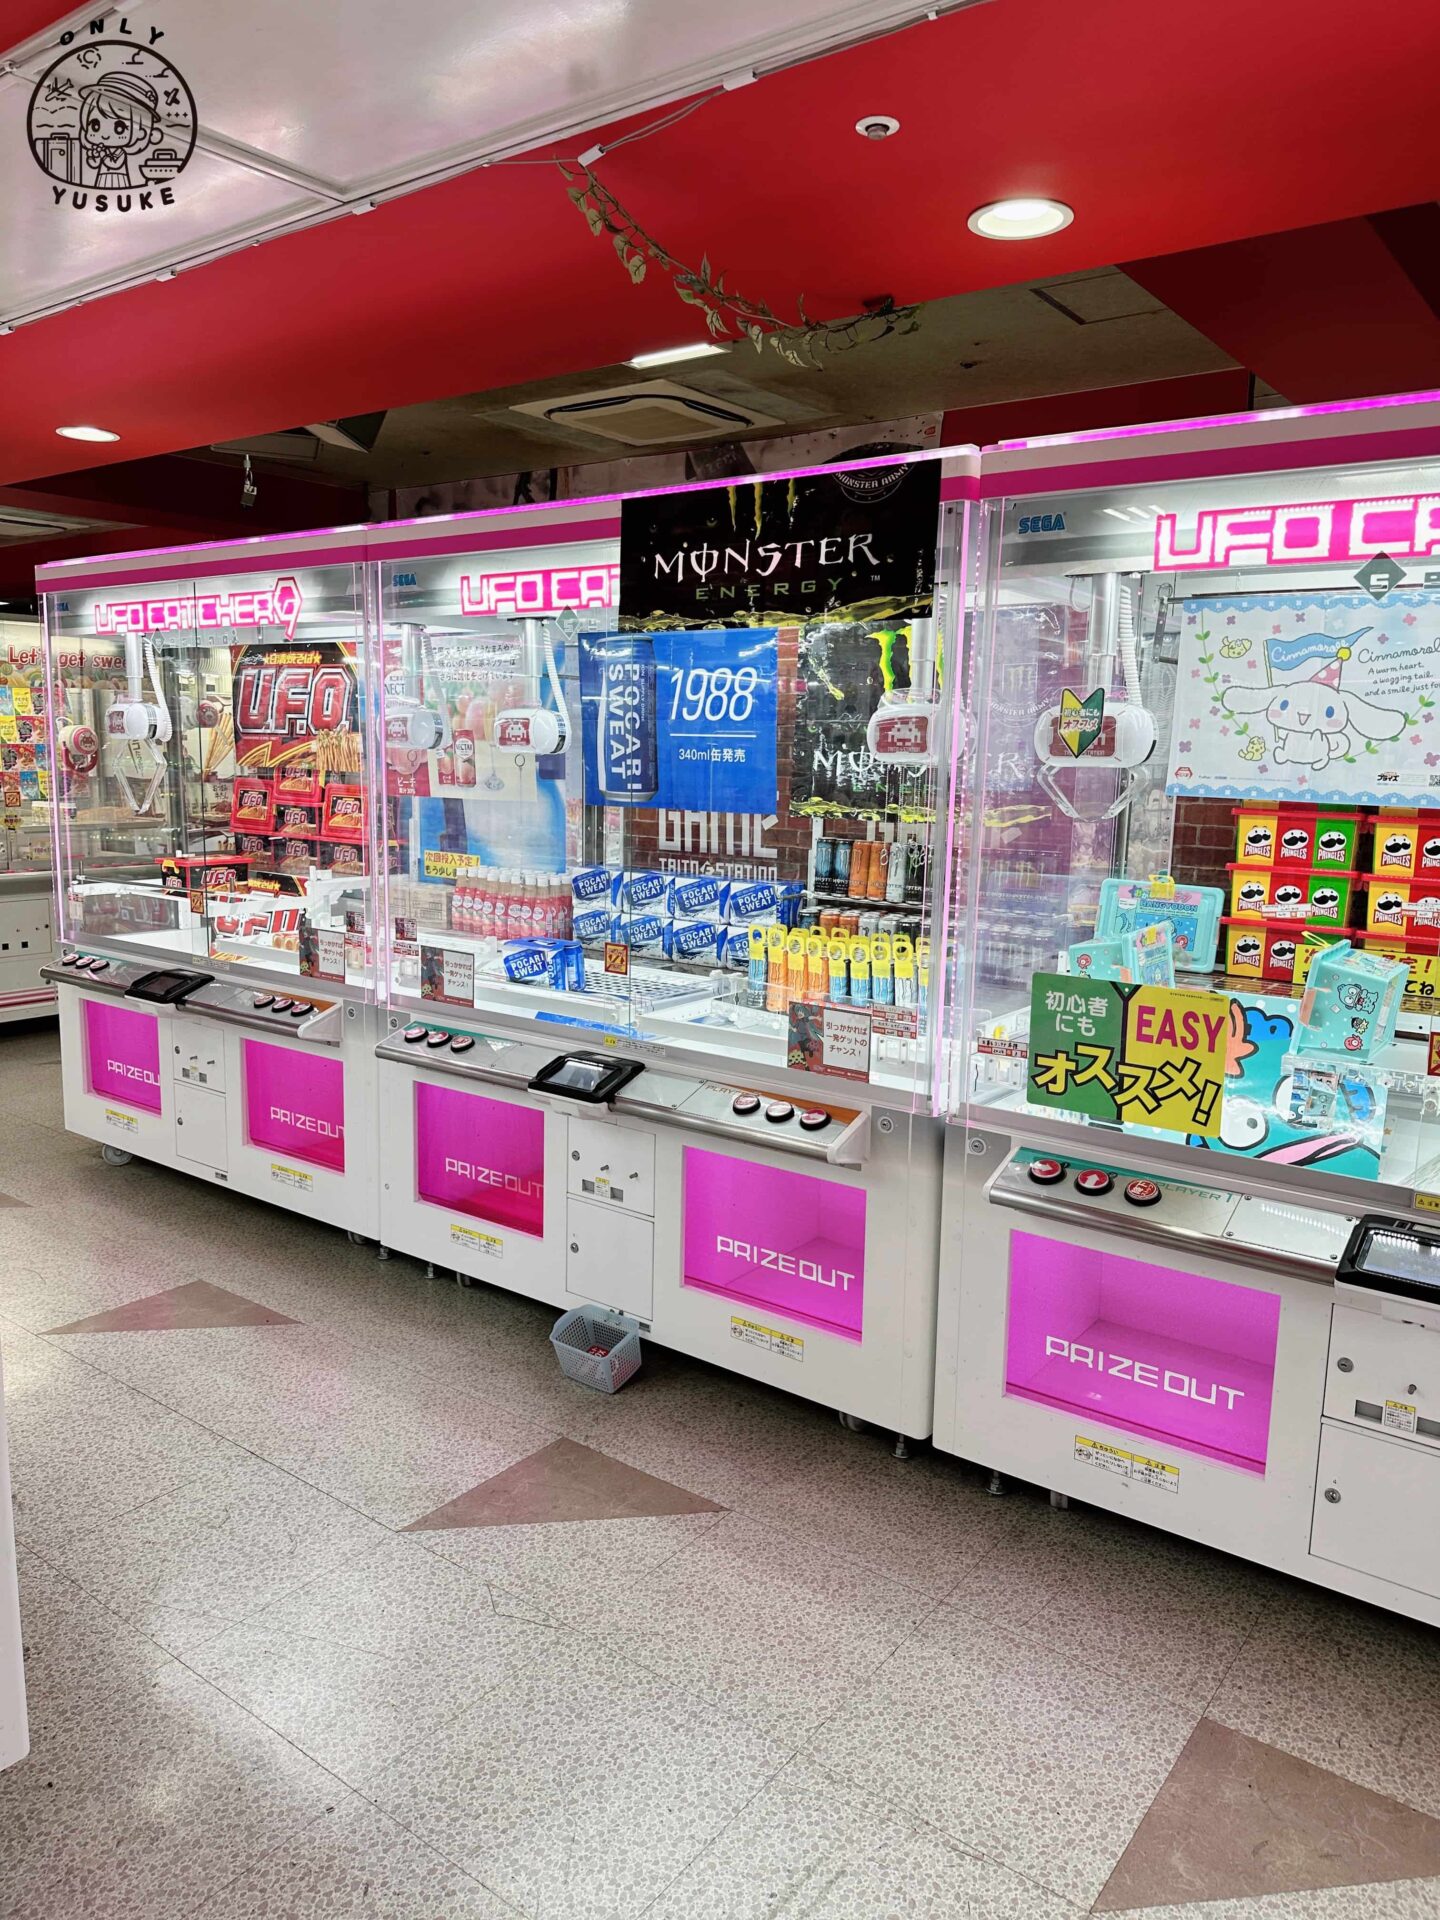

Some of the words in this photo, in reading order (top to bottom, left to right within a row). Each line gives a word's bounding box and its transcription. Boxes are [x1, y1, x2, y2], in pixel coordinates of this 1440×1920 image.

[1018, 514, 1066, 535] SEGA
[1155, 504, 1334, 570] UFO
[654, 533, 880, 584] MONSTER
[393, 573, 416, 586] SEGA
[461, 572, 545, 616] UFO
[695, 577, 844, 600] ENERGY
[95, 603, 145, 635] UFO
[147, 592, 276, 632] CATCHER
[1271, 640, 1349, 663] Cinnamoroll
[1358, 636, 1440, 664] Cinnamorol
[58, 651, 87, 668] get
[1375, 667, 1398, 675] warm
[1379, 675, 1412, 686] wagging
[670, 666, 758, 722] 1988
[1364, 688, 1380, 697] and
[1387, 685, 1411, 695] smile
[1411, 683, 1428, 694] just
[608, 663, 627, 780] SWEAT
[1063, 708, 1100, 718] 初心者にも
[624, 663, 643, 790] POCARI
[1063, 718, 1099, 731] オススメ
[678, 748, 746, 763] 340ml缶発売
[1244, 845, 1271, 858] PRINGLES
[1280, 848, 1307, 861] PRINGLES
[1317, 851, 1345, 863] PRINGLES
[1382, 854, 1411, 867] PRINGLES
[1421, 856, 1440, 868] PRING
[631, 877, 663, 895] POCARI
[682, 884, 717, 901] POCARI
[684, 892, 715, 909] SWEAT
[738, 888, 774, 906] POCARI
[739, 897, 772, 914] SWEAT
[1140, 899, 1198, 912] HANGYODON
[1311, 905, 1338, 919] PRINGLES
[1374, 910, 1402, 926] PRINGLES
[680, 926, 717, 943] POCARI
[682, 934, 715, 951] SWEAT
[511, 953, 544, 971] POCARI
[1234, 954, 1260, 967] PRINGLES
[513, 962, 543, 979] SWEAT
[1045, 990, 1108, 1018] 初心者
[825, 1021, 868, 1036] 引っかかれば
[1054, 1013, 1096, 1037] にも
[1135, 1005, 1226, 1053] EASY
[825, 1033, 868, 1047] 一発ゲットの
[107, 1059, 160, 1087] PRIZEOU
[1157, 1182, 1222, 1201] PLAYER
[1224, 1192, 1233, 1204] 1
